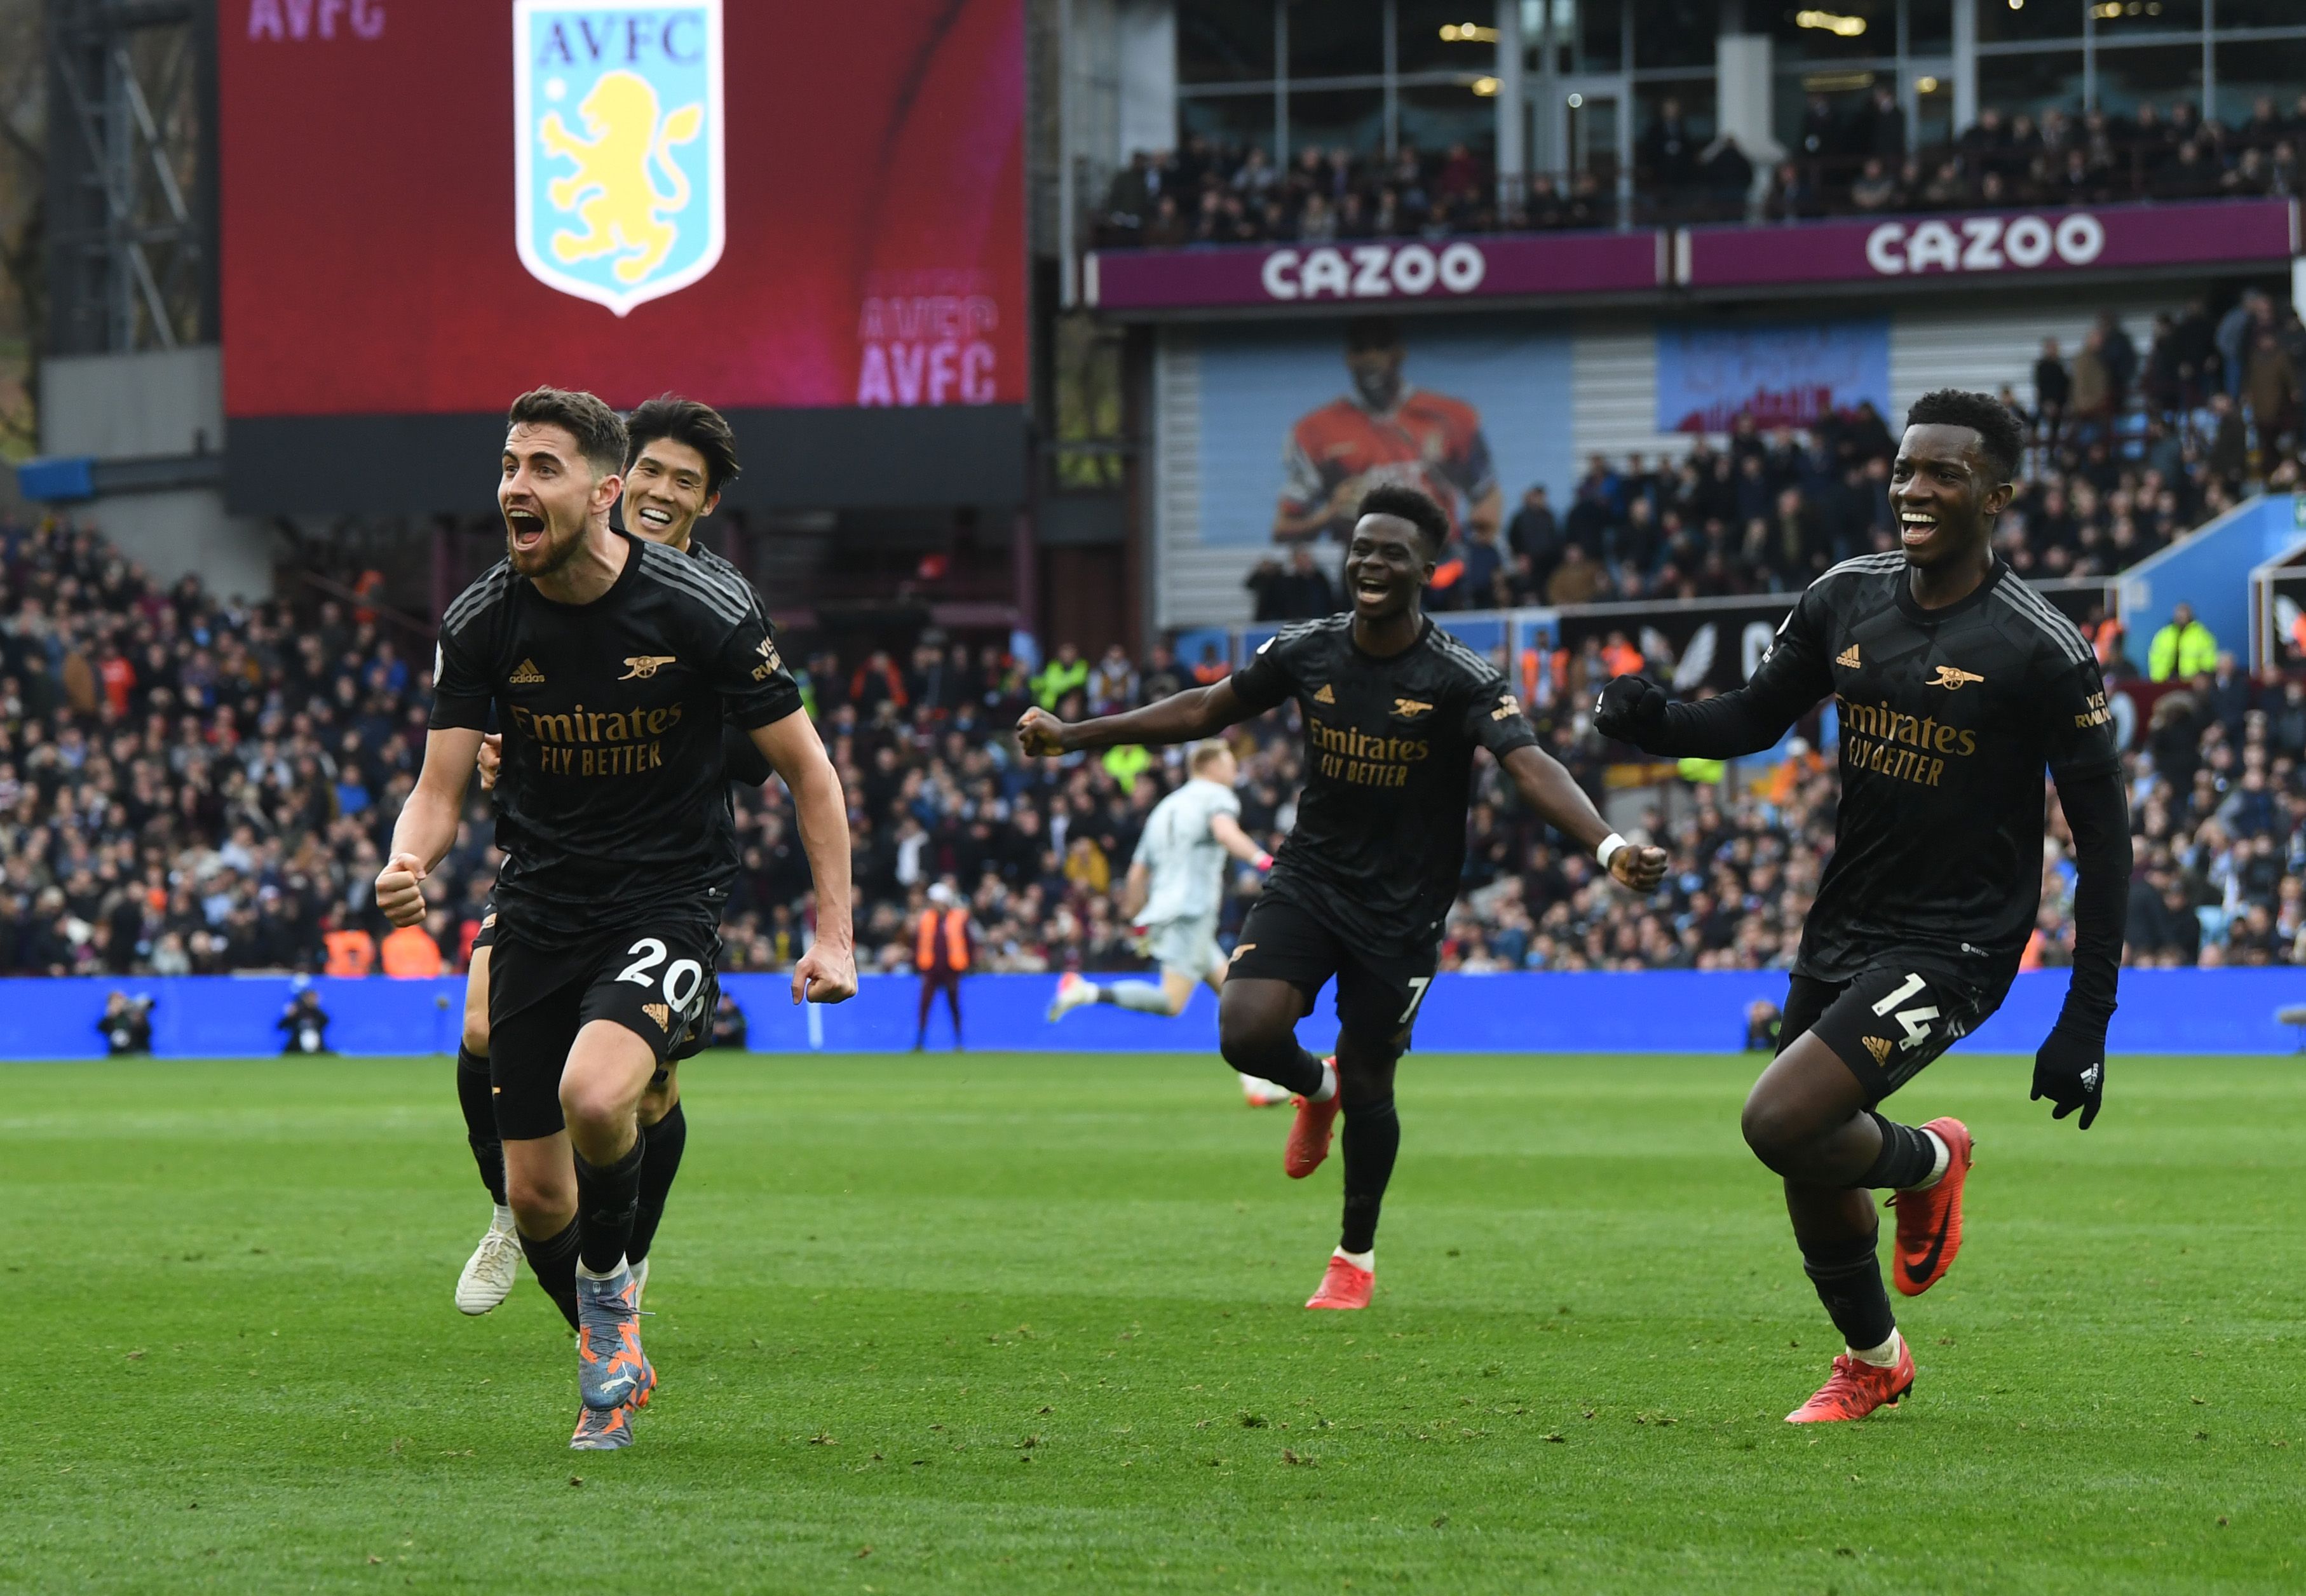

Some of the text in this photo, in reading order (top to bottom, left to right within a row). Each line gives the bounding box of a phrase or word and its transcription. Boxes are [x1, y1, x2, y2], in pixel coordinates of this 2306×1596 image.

[538, 11, 702, 66] AVFC
[1865, 212, 2106, 275] CAZOO
[1261, 241, 1486, 300] CAZOO
[858, 341, 996, 407] AVFC
[509, 673, 545, 684] adidas
[1836, 656, 1861, 668] adidas
[510, 701, 682, 742] Emirates
[1310, 717, 1428, 761] Emirates
[541, 741, 662, 776] FLY BETTER
[1321, 754, 1408, 787] FLY BETTER
[1848, 736, 1944, 787] FLY BETTER
[614, 938, 703, 1013] 20
[1399, 977, 1430, 1024] 7
[1871, 973, 1940, 1052] 14
